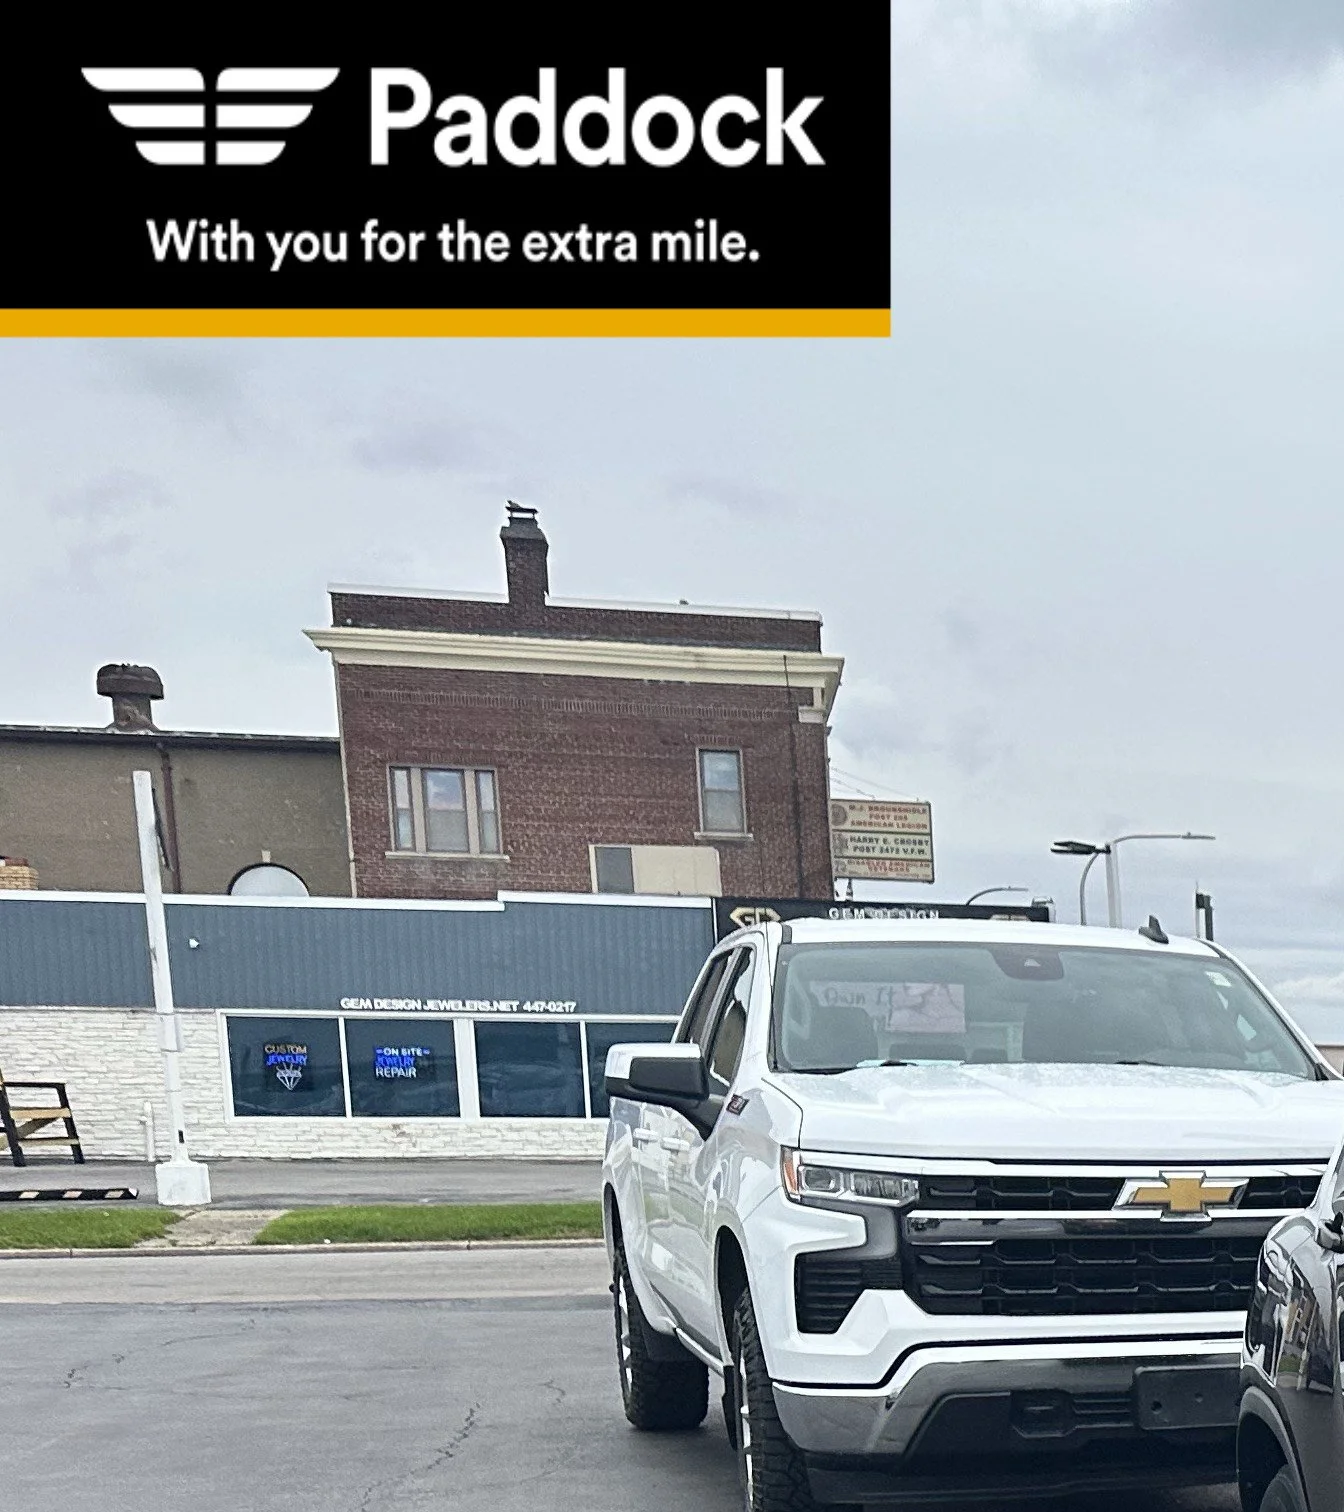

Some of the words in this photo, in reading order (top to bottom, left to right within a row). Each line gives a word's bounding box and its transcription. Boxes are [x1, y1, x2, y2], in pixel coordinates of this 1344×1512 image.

[340, 997, 372, 1010] GEM
[374, 998, 422, 1011] DESIGN
[265, 1044, 308, 1055] CUSTOM
[376, 1066, 418, 1079] REPAIR
